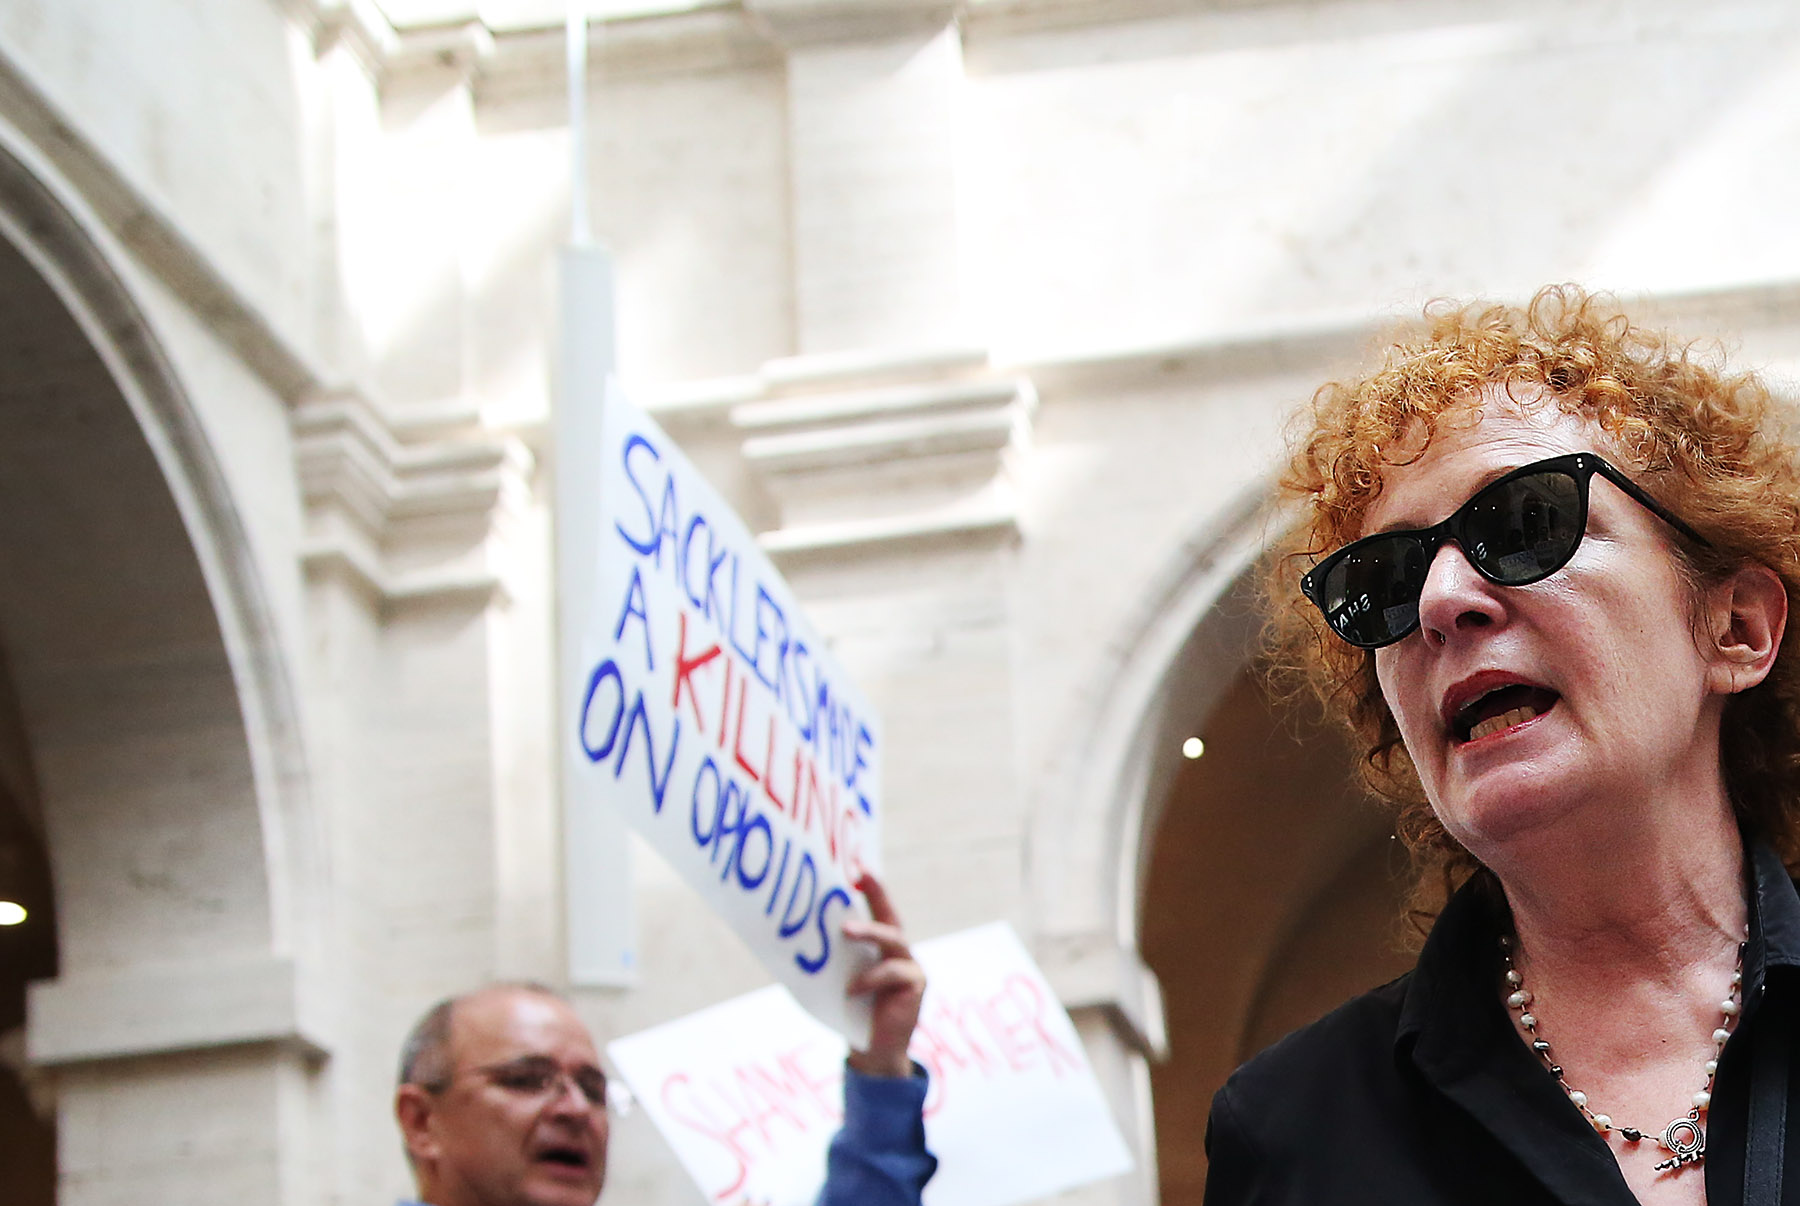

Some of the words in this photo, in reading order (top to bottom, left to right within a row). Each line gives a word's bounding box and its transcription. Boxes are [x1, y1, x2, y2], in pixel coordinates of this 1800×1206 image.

[579, 658, 681, 815] ON
[691, 755, 852, 976] OPIOIDS
[615, 565, 654, 671] A
[672, 609, 866, 890] KILLING
